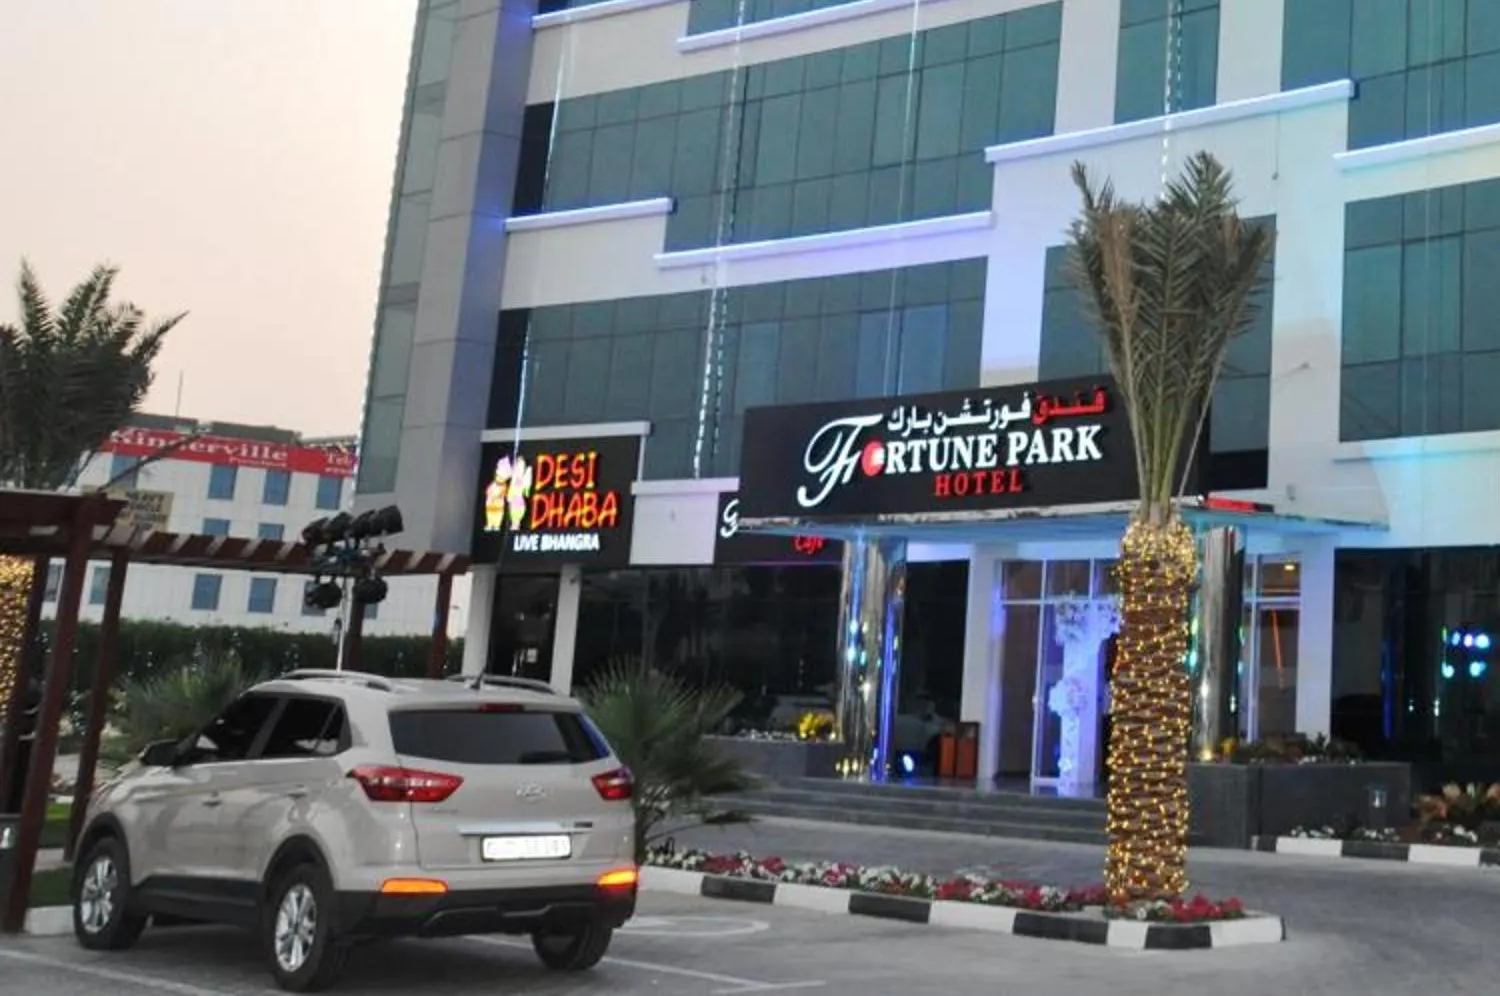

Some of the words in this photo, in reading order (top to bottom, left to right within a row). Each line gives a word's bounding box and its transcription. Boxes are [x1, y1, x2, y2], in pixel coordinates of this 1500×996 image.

[886, 405, 933, 437] بارك
[933, 392, 1032, 435] فورتشن
[1033, 387, 1107, 425] فندق
[535, 452, 597, 489] DESI
[797, 413, 998, 507] FORTUNE
[1006, 424, 1103, 466] PARK
[934, 469, 1023, 498] HOTEL
[530, 491, 618, 530] DHABA
[513, 532, 539, 552] LIVE
[540, 531, 600, 552] BHANGRA
